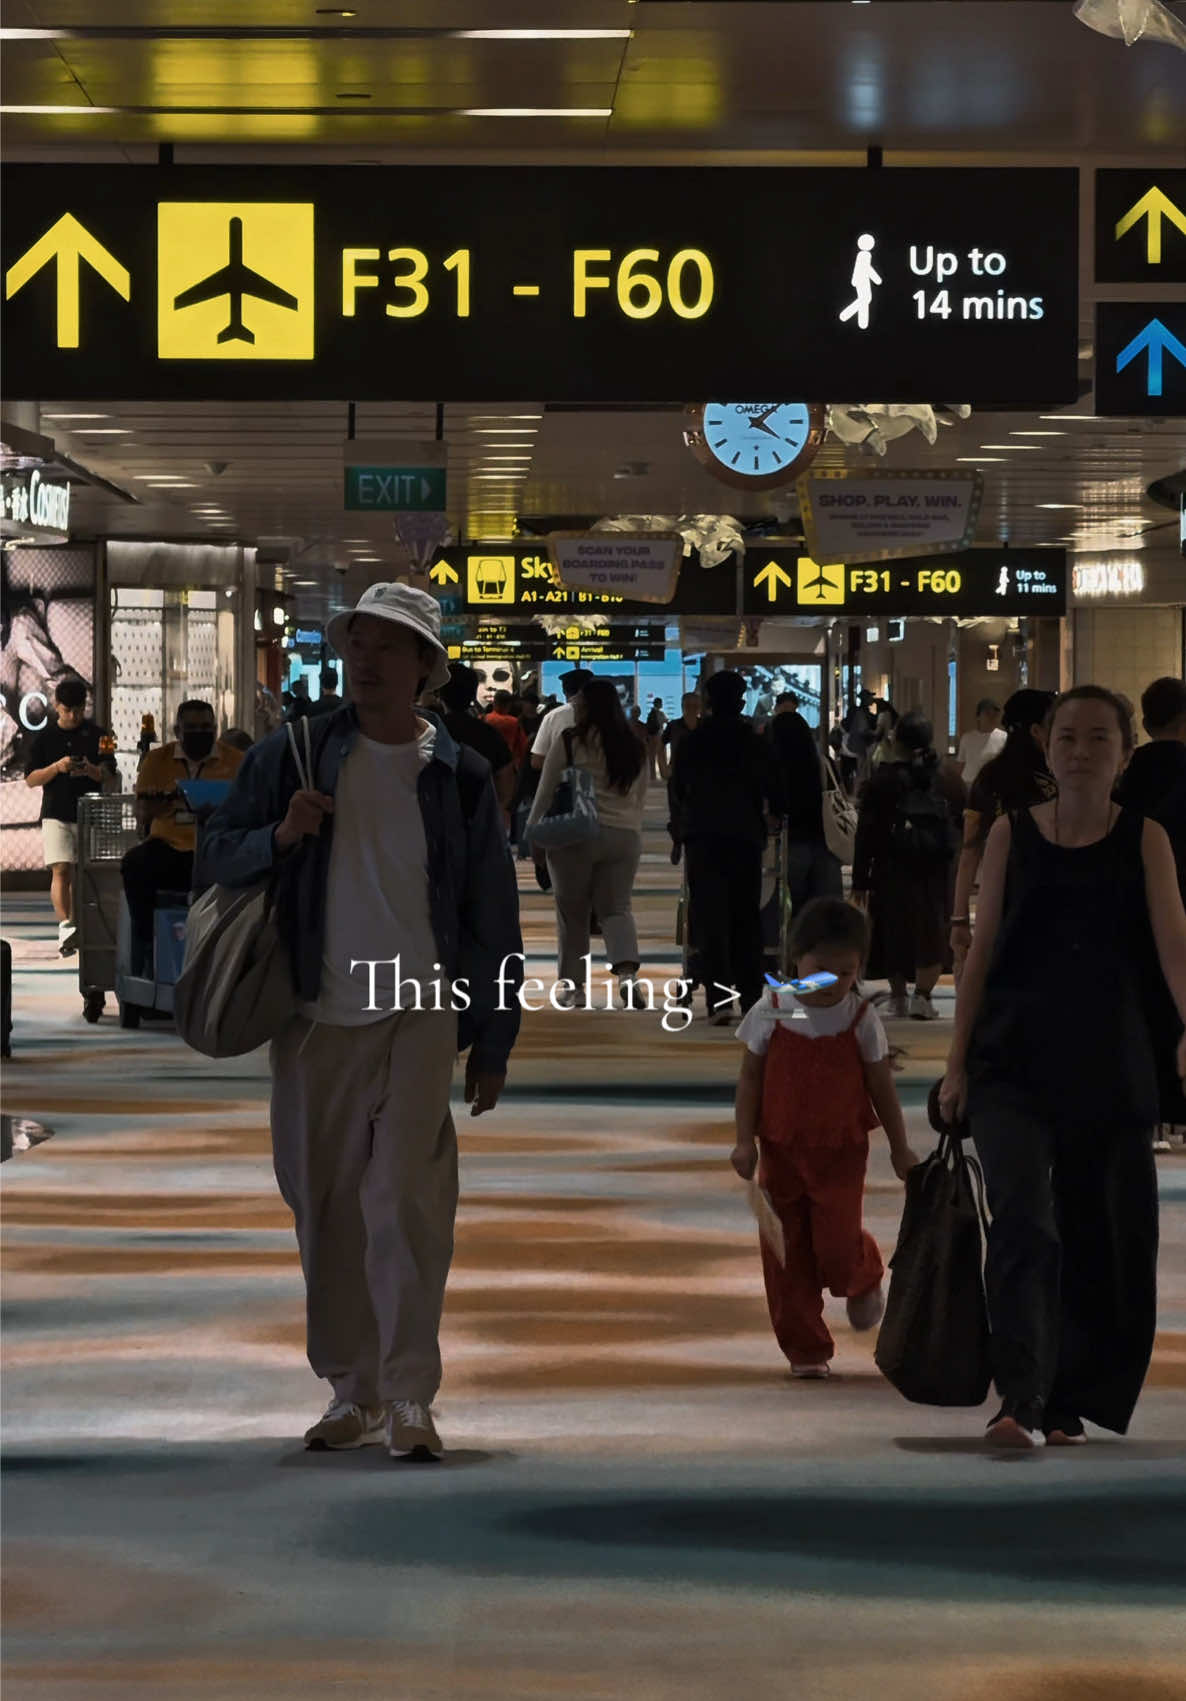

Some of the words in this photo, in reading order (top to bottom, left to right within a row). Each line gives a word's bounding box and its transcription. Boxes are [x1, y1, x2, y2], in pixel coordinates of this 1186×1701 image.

[909, 245, 958, 283] Up
[967, 248, 1007, 276] to
[342, 248, 470, 317] F31
[573, 248, 714, 319] F60
[912, 289, 952, 320] 14
[962, 289, 1044, 320] mins
[359, 474, 416, 504] EXIT
[818, 495, 871, 507] SHOP.
[924, 495, 962, 508] WIN.
[577, 546, 613, 555] SCAN
[615, 546, 650, 555] YOUR
[589, 573, 608, 583] TO
[850, 570, 890, 593] F31
[917, 570, 961, 593] F60
[1015, 569, 1032, 582] Up
[1033, 570, 1046, 580] to
[1017, 583, 1029, 593] 11
[1031, 583, 1057, 593] mins
